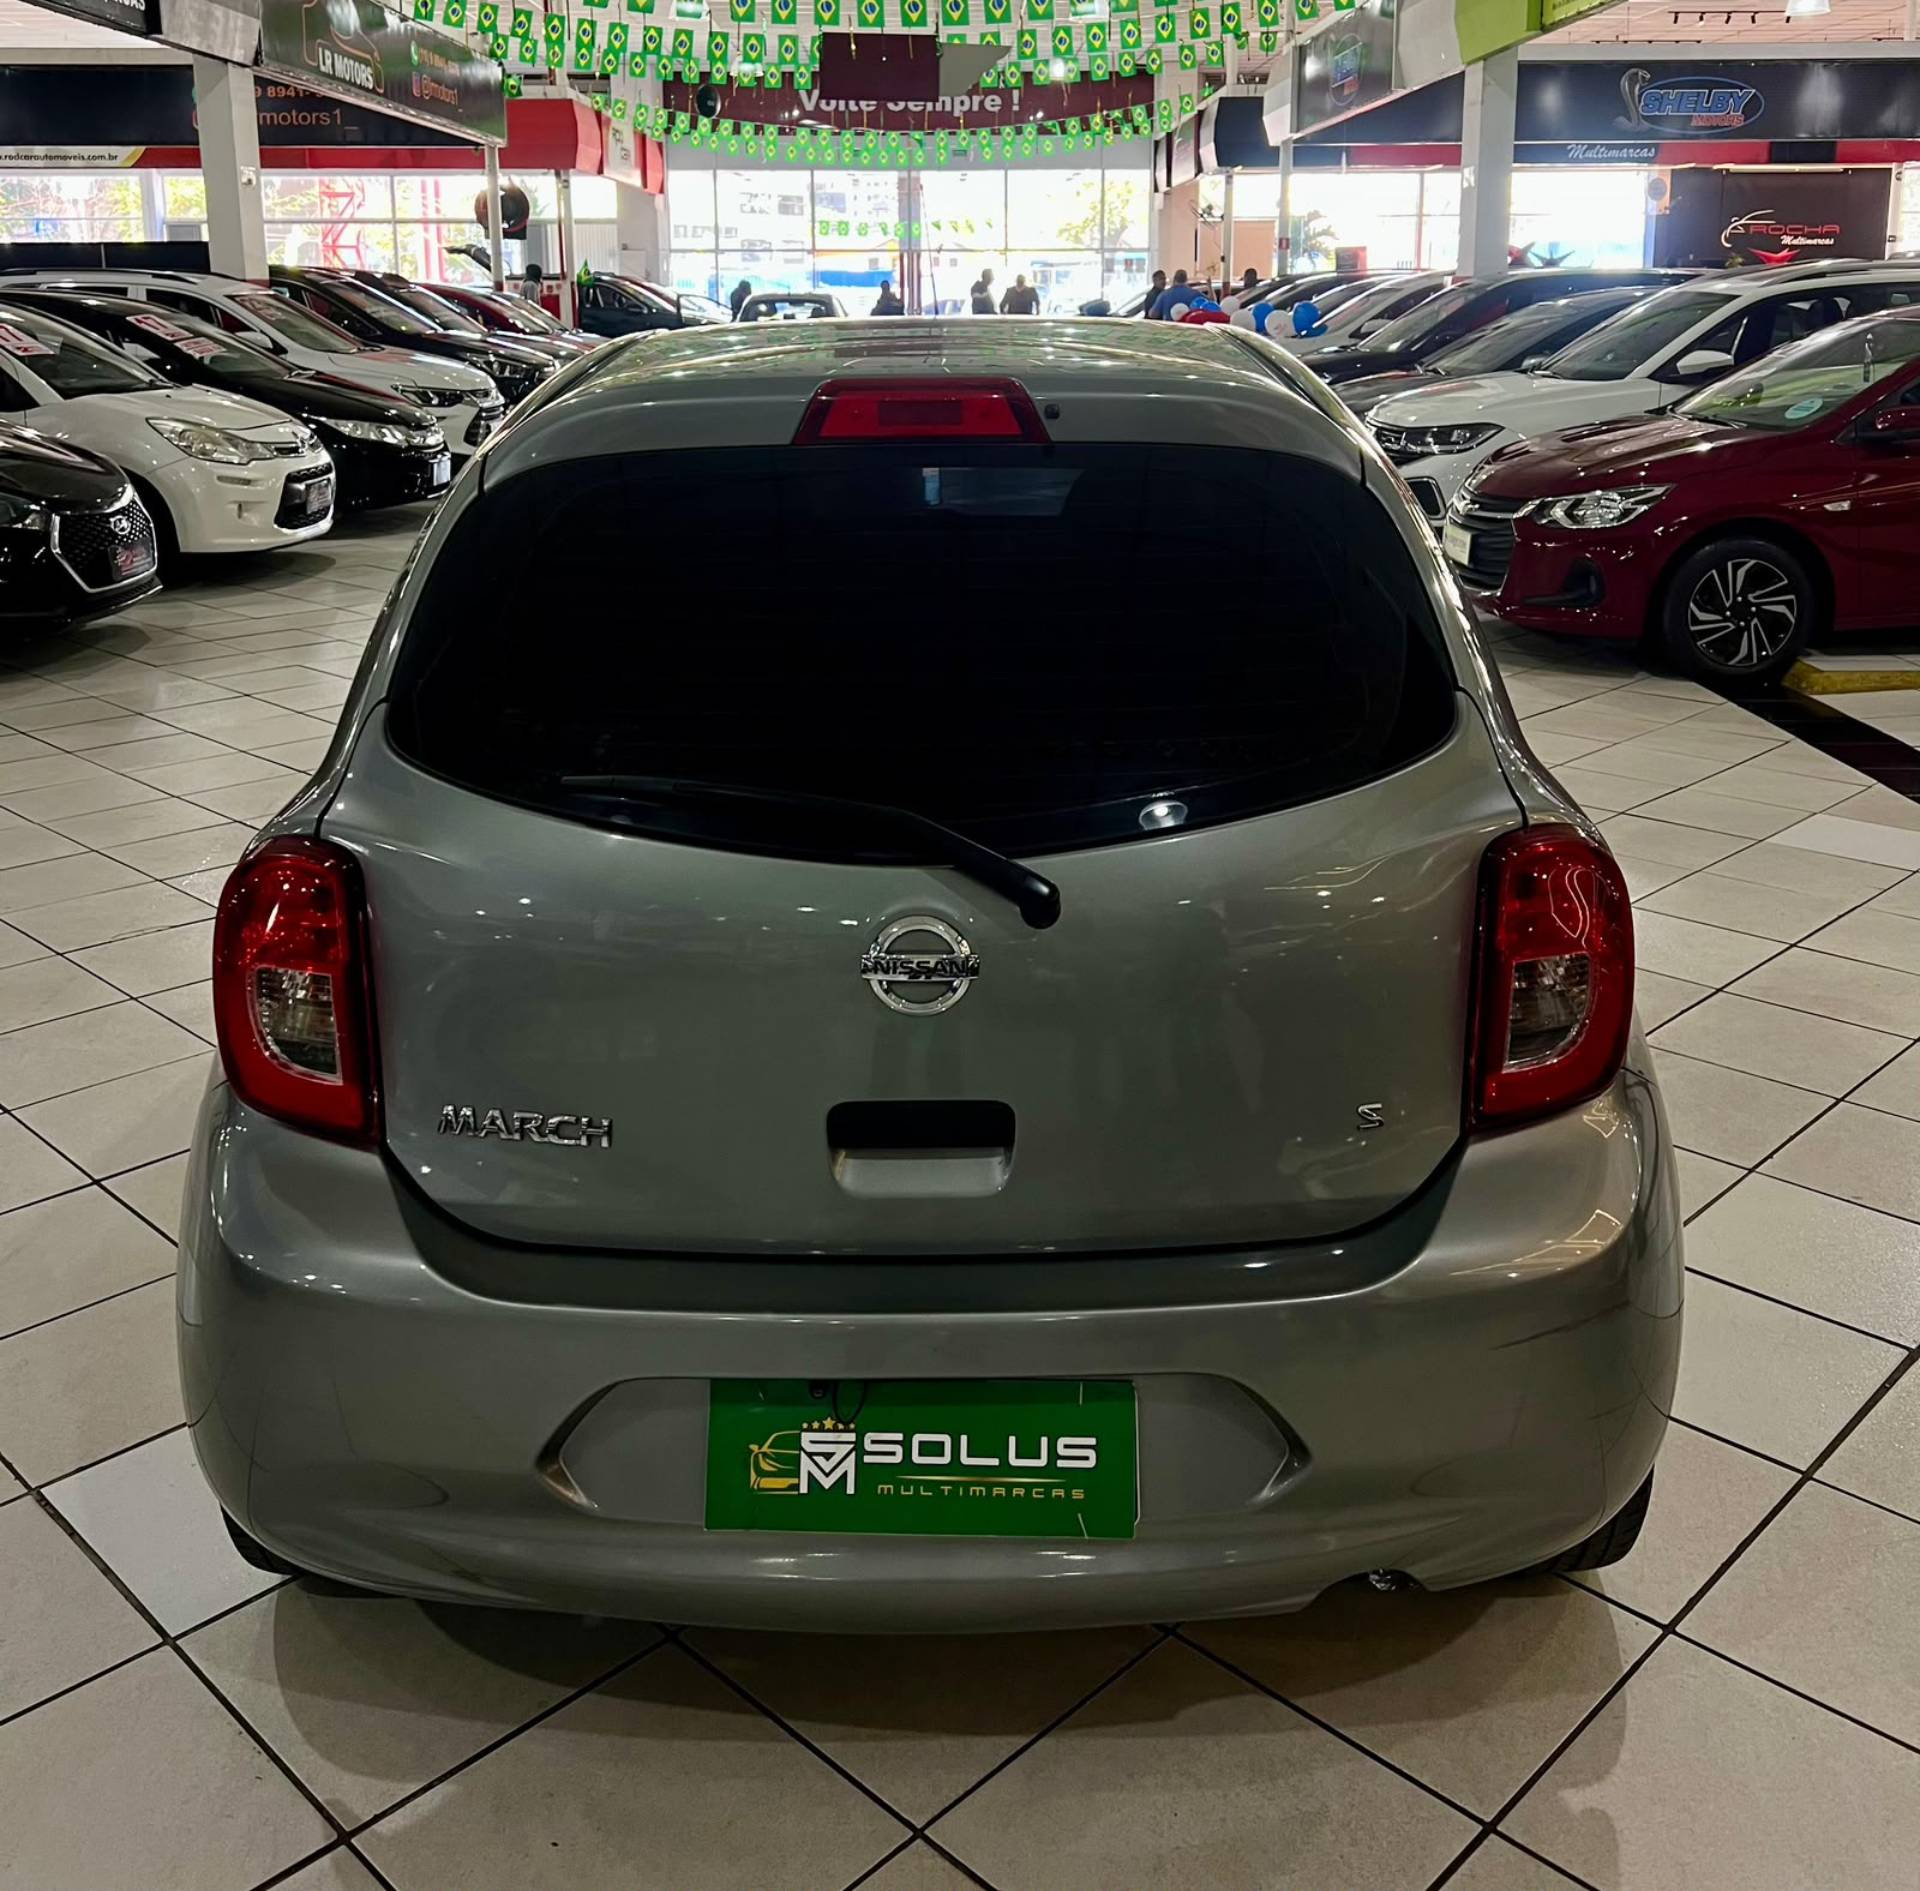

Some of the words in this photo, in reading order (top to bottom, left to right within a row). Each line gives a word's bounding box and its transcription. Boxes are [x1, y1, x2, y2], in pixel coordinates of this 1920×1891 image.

[319, 47, 333, 75] LR
[334, 53, 374, 90] MOTORS
[1639, 89, 1755, 116] SHELBY
[1691, 114, 1745, 127] MOTORS
[1566, 143, 1656, 159] Multimarcas
[1750, 224, 1840, 235] ROCHA
[1780, 235, 1835, 245] Multimarcas
[872, 959, 967, 976] NISSAN
[1357, 1103, 1384, 1129] S
[438, 1104, 611, 1148] MARCH
[863, 1432, 1097, 1469] SOLUS
[877, 1484, 1085, 1500] MULTIMARCAS
